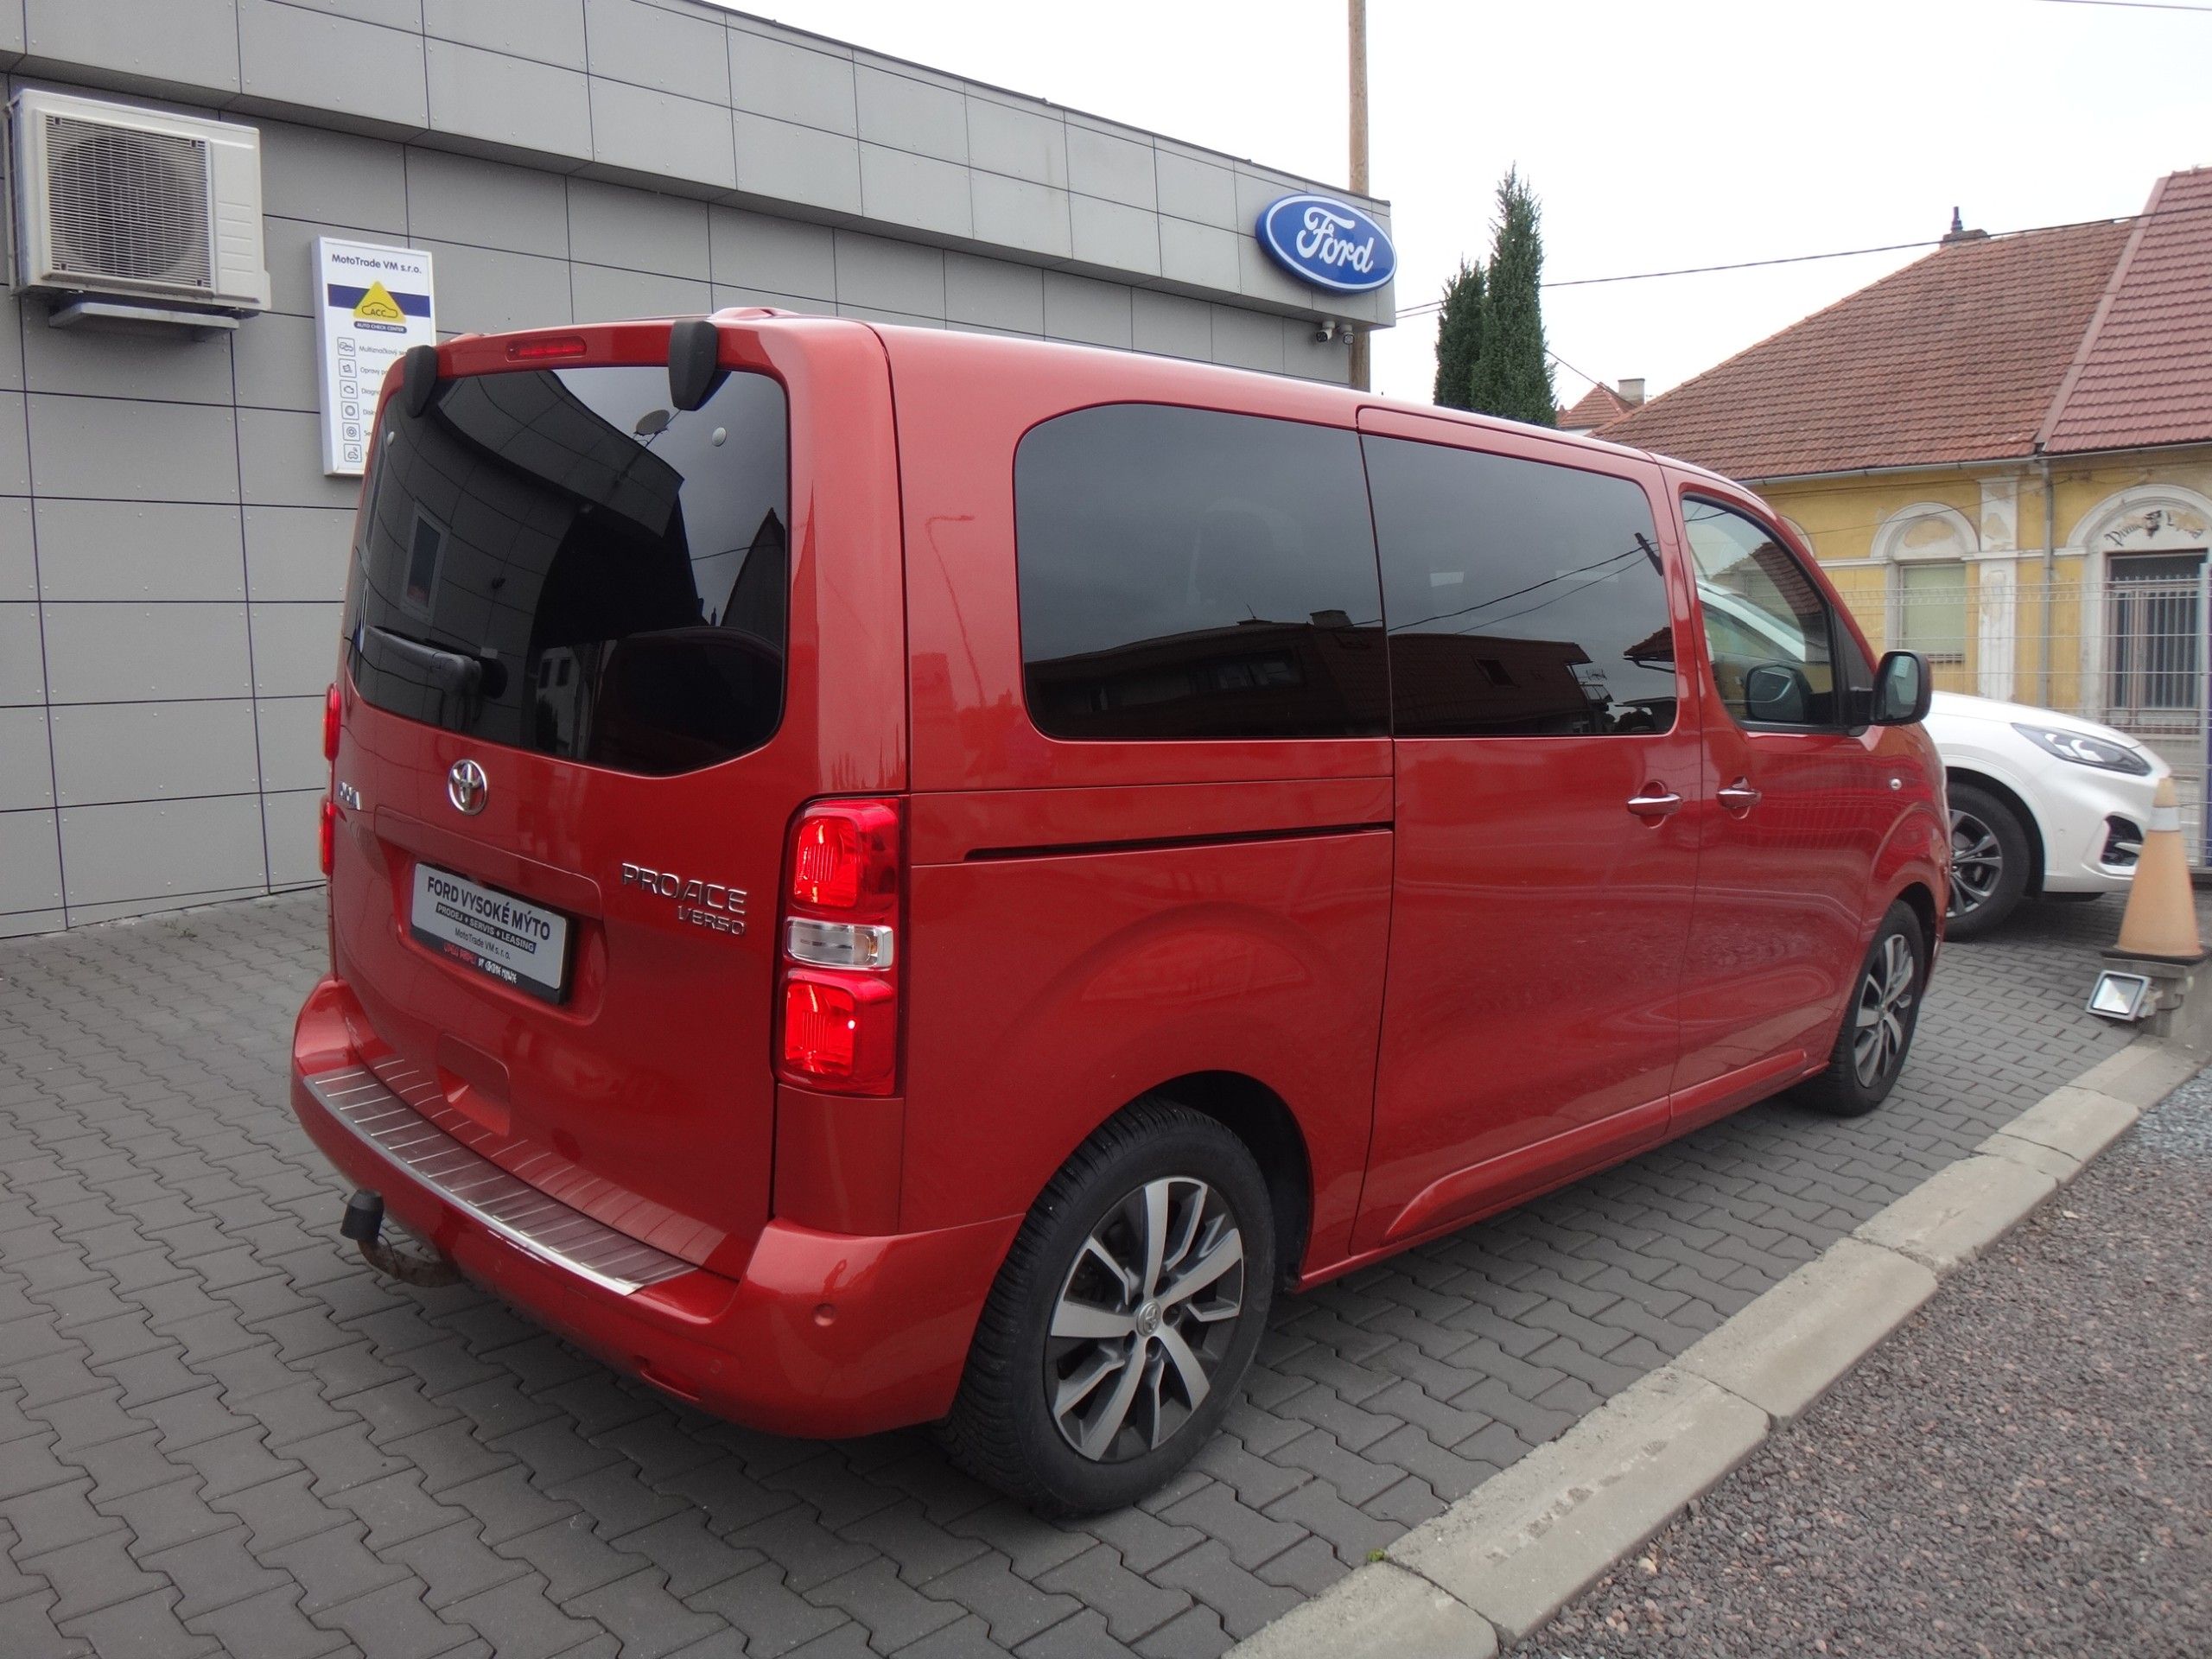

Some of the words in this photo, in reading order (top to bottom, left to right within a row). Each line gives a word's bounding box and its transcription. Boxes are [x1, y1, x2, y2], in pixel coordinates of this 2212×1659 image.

[1296, 207, 1374, 273] Ford
[332, 253, 381, 268] MotoTrade
[383, 261, 398, 270] VM
[400, 264, 423, 274] s.r.o.
[370, 308, 386, 317] ACC
[427, 875, 460, 903] FORD
[461, 888, 510, 925] VYSOKÉ
[511, 910, 550, 941] MÝTO
[622, 862, 747, 915] PROACE
[437, 904, 464, 922] PRODEJ
[469, 918, 495, 936] SERVIS
[501, 931, 534, 951] LEASING
[454, 927, 484, 948] MotoTrade
[677, 905, 747, 936] VERSO
